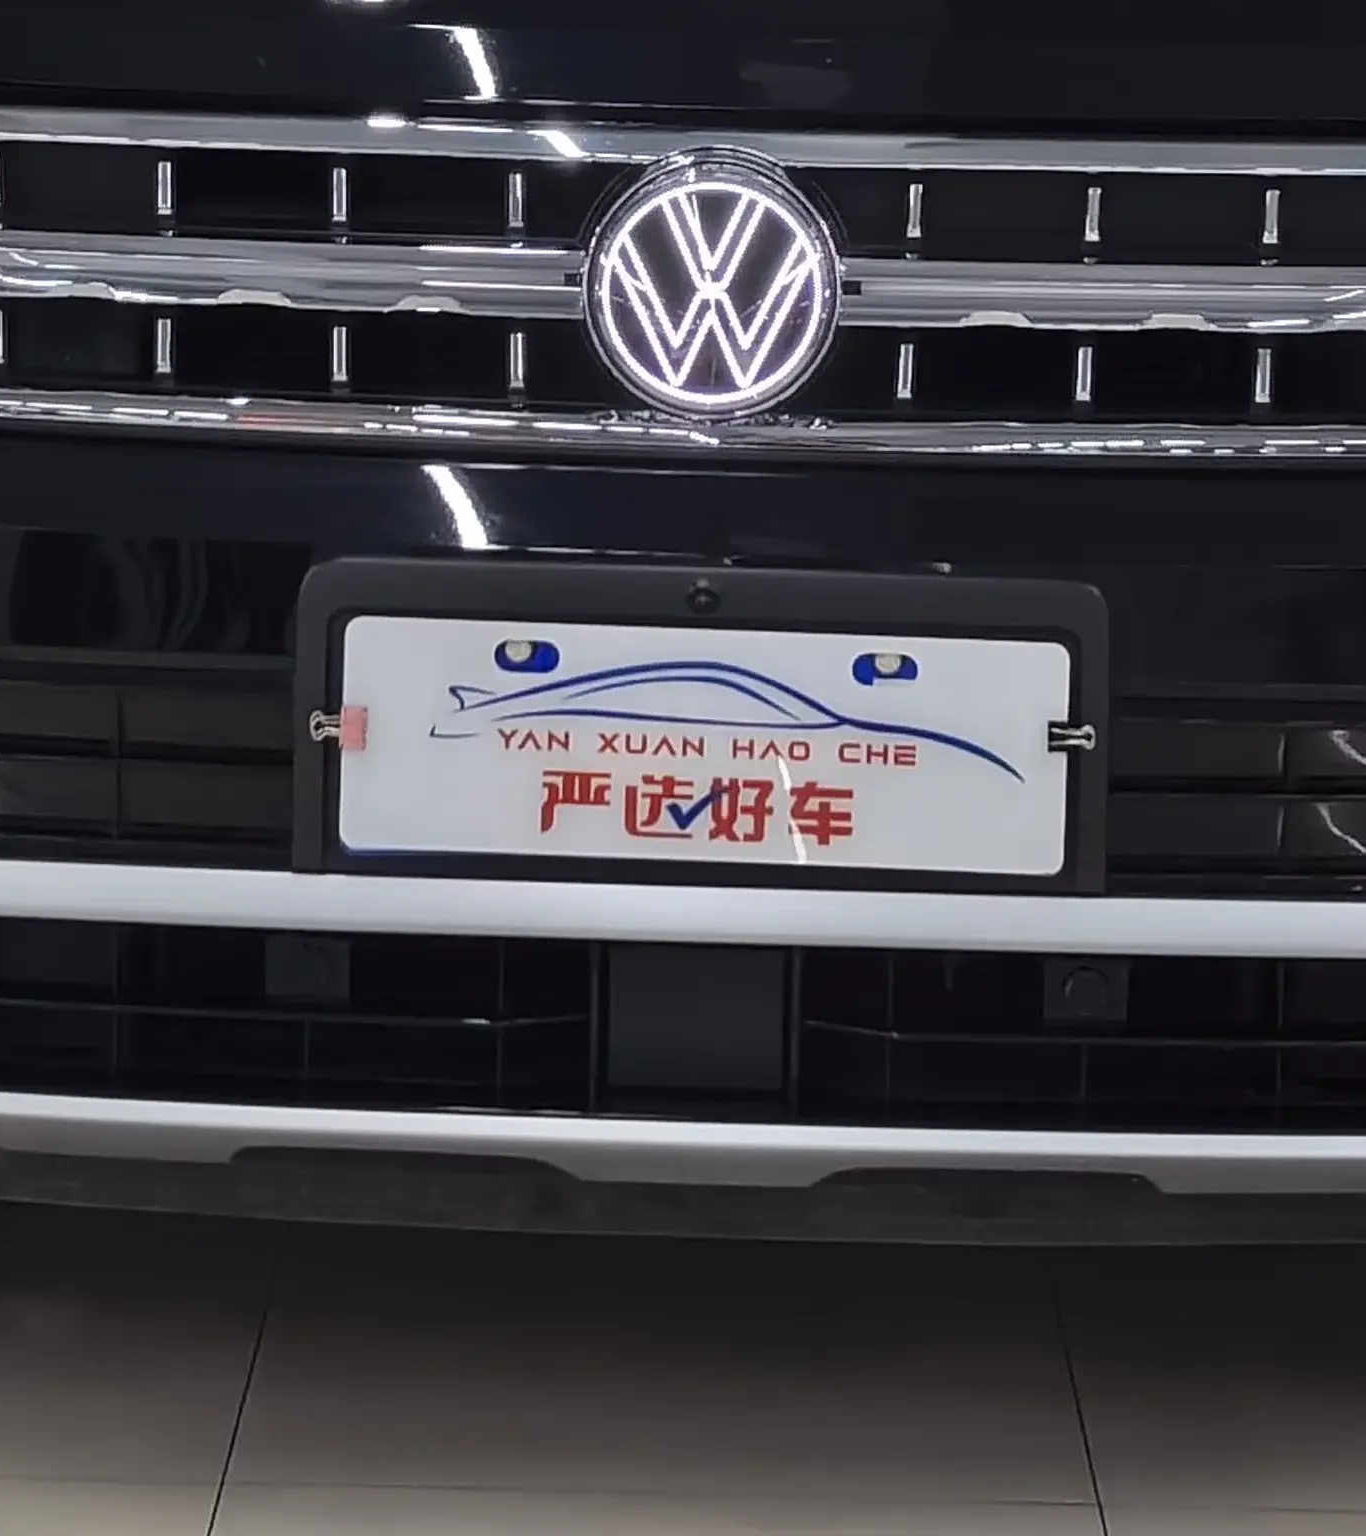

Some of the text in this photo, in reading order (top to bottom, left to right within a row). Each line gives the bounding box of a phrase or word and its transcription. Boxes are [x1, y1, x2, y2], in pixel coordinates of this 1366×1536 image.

[497, 728, 918, 766] YAN XUAN HAO CHE
[540, 770, 854, 846] 严选好车
